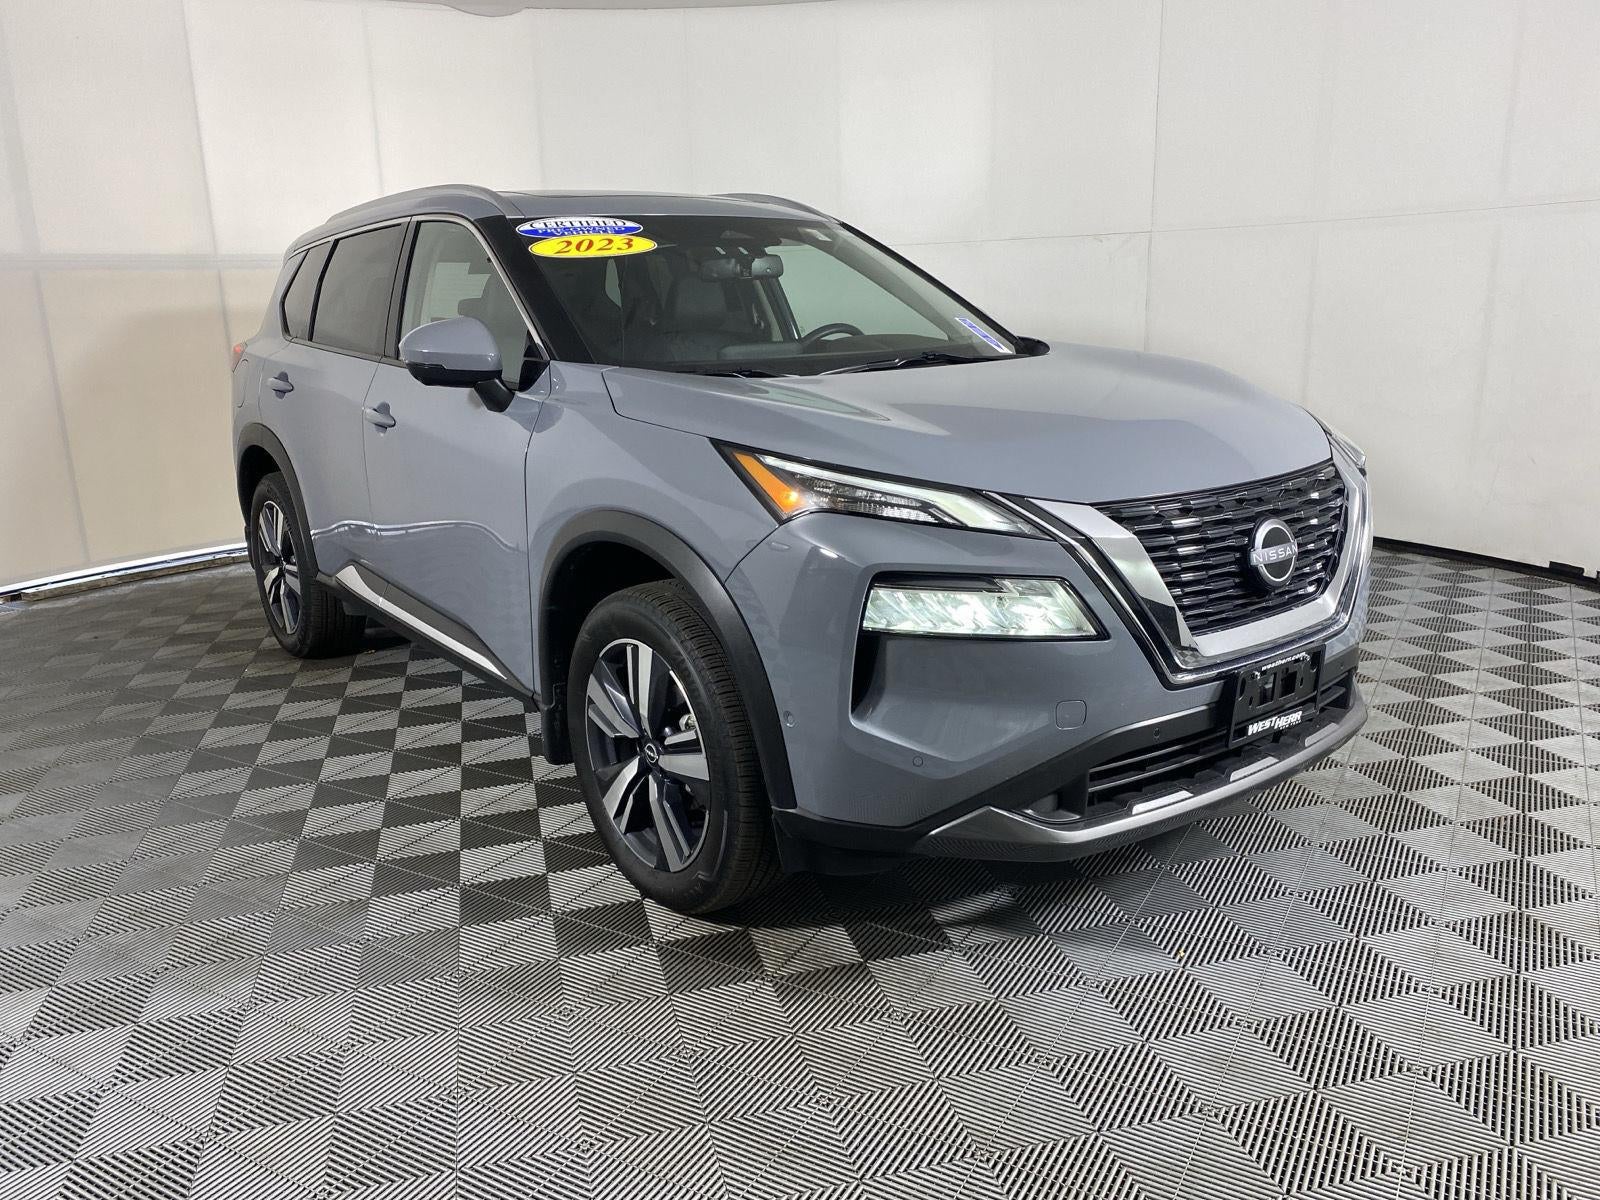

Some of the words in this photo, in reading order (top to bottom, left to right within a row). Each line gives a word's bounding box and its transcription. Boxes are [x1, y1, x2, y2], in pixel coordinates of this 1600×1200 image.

[530, 220, 626, 229] CERTIFIED
[538, 226, 625, 234] PRE-OWNED
[553, 238, 634, 254] 2023
[1252, 544, 1298, 563] NISSAN
